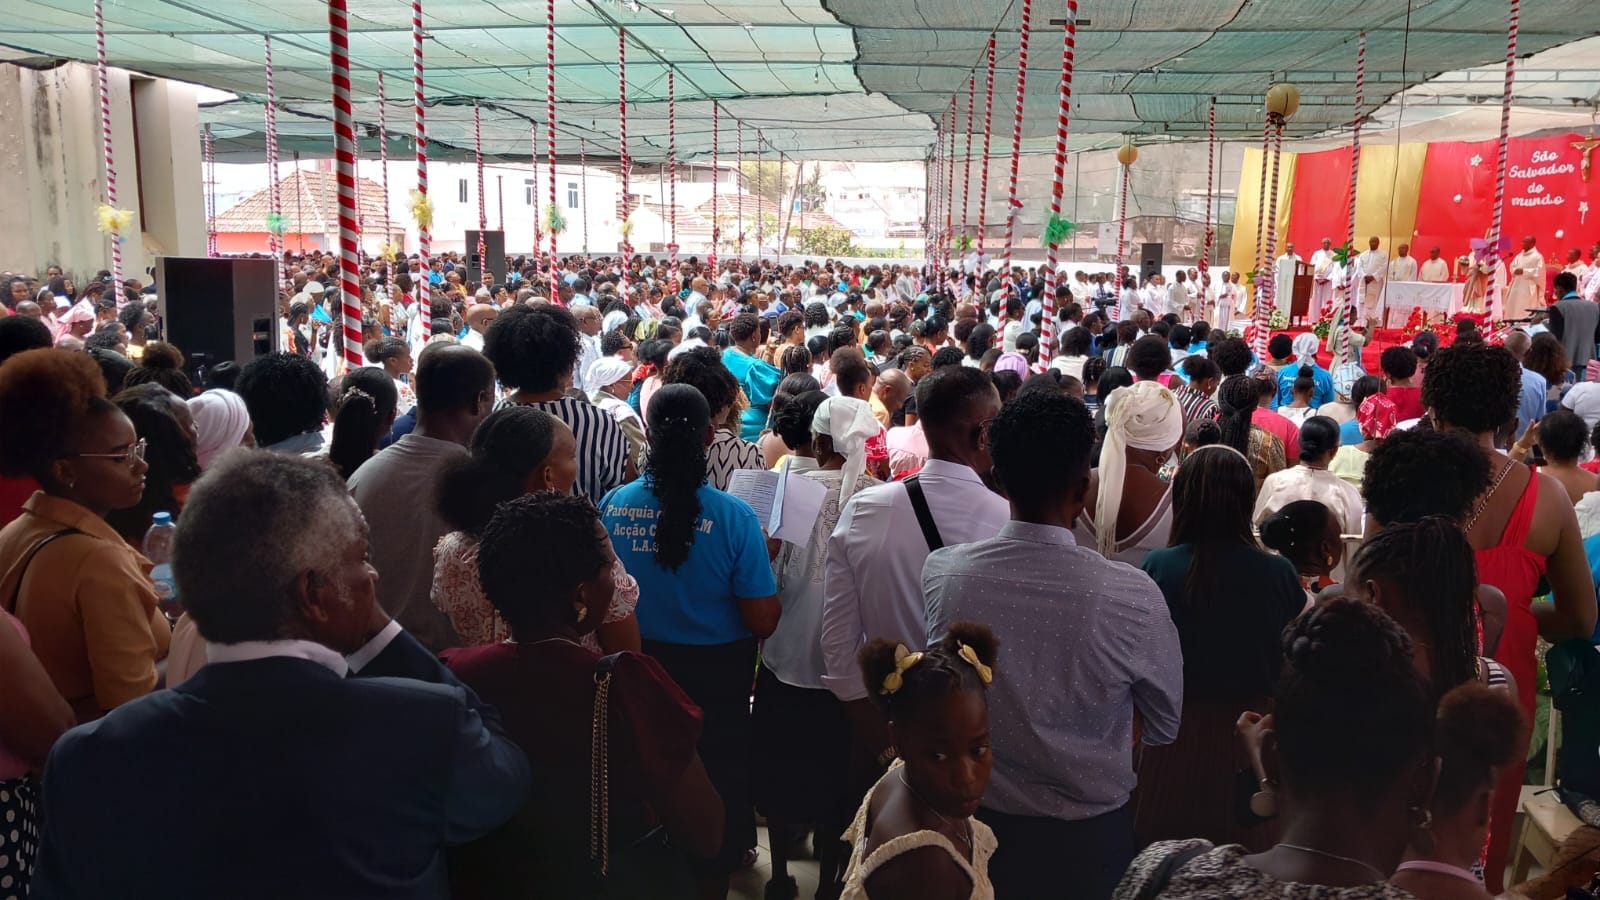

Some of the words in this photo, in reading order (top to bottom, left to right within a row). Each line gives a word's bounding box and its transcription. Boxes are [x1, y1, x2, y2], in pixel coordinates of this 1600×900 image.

[1531, 151, 1559, 163] São
[1508, 163, 1575, 178] Salvador
[1511, 194, 1565, 206] mundo
[606, 504, 654, 521] Paróquia
[613, 523, 646, 539] Acção
